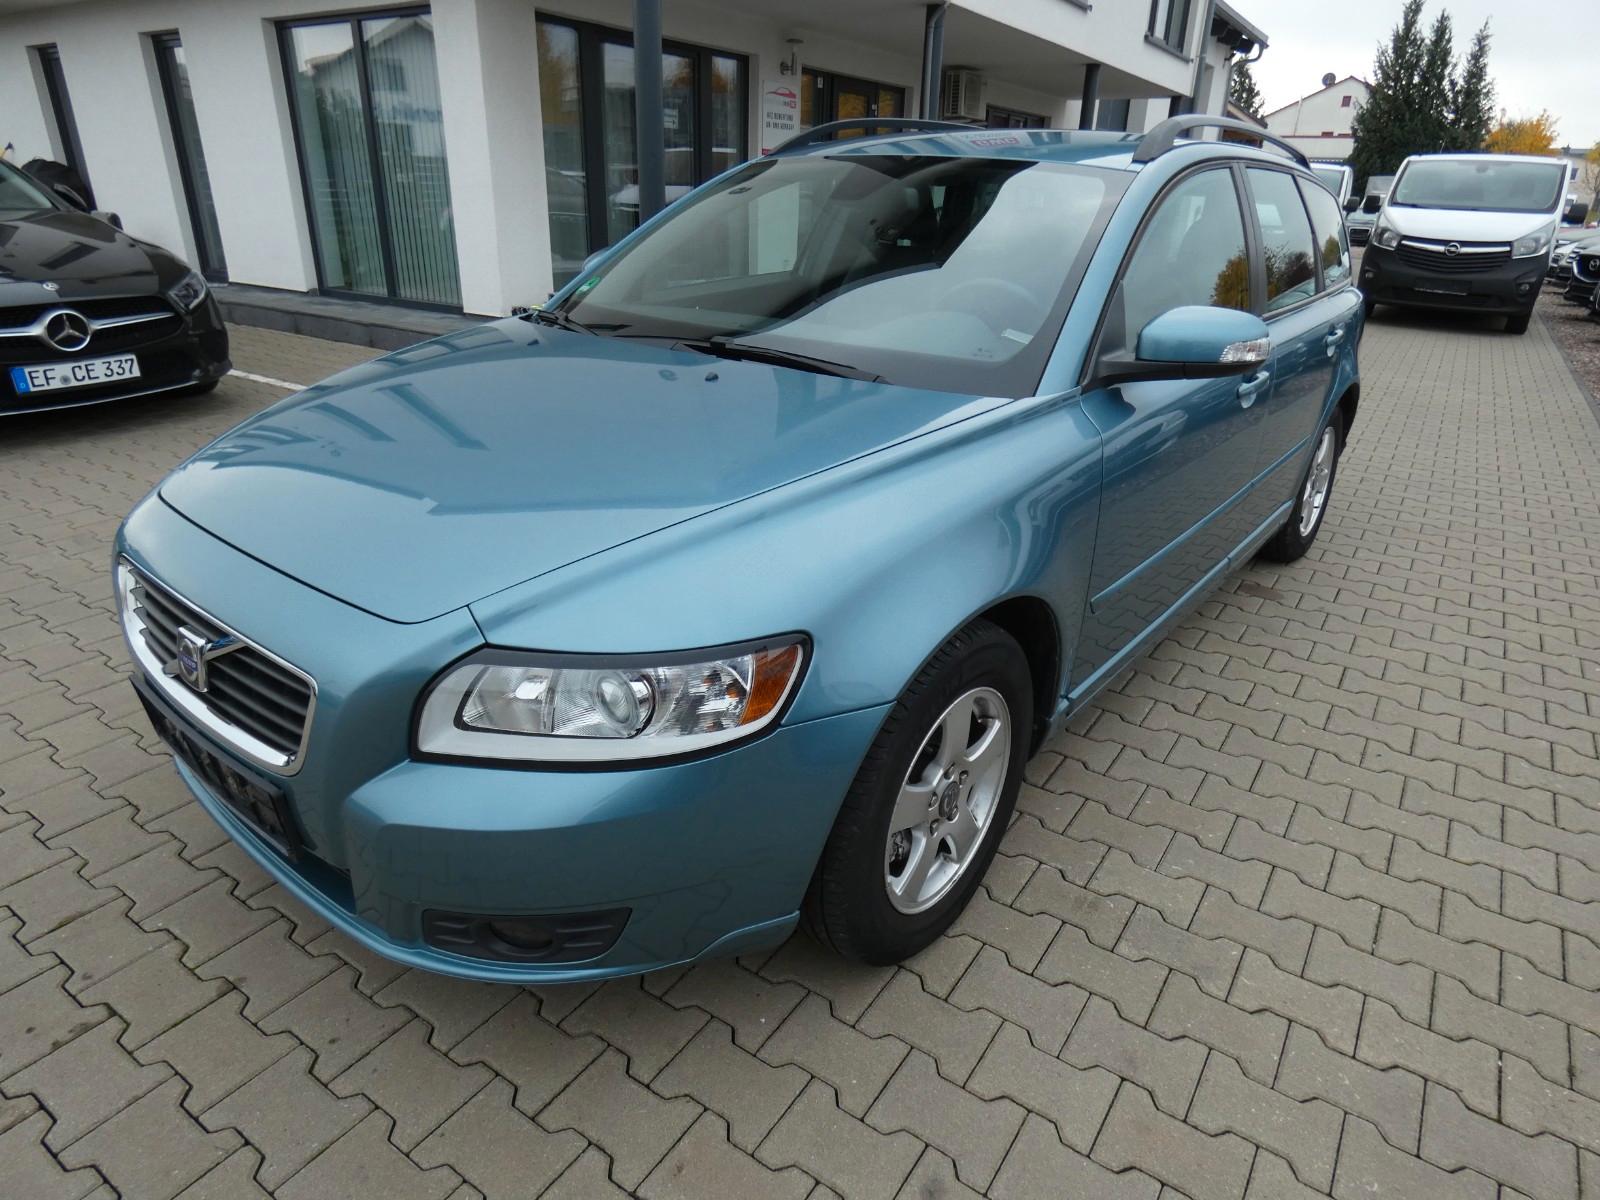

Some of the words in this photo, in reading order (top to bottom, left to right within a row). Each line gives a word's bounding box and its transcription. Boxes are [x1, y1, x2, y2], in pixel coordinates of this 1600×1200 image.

[28, 368, 56, 388] EF
[72, 363, 99, 382] CE
[102, 358, 134, 377] 337
